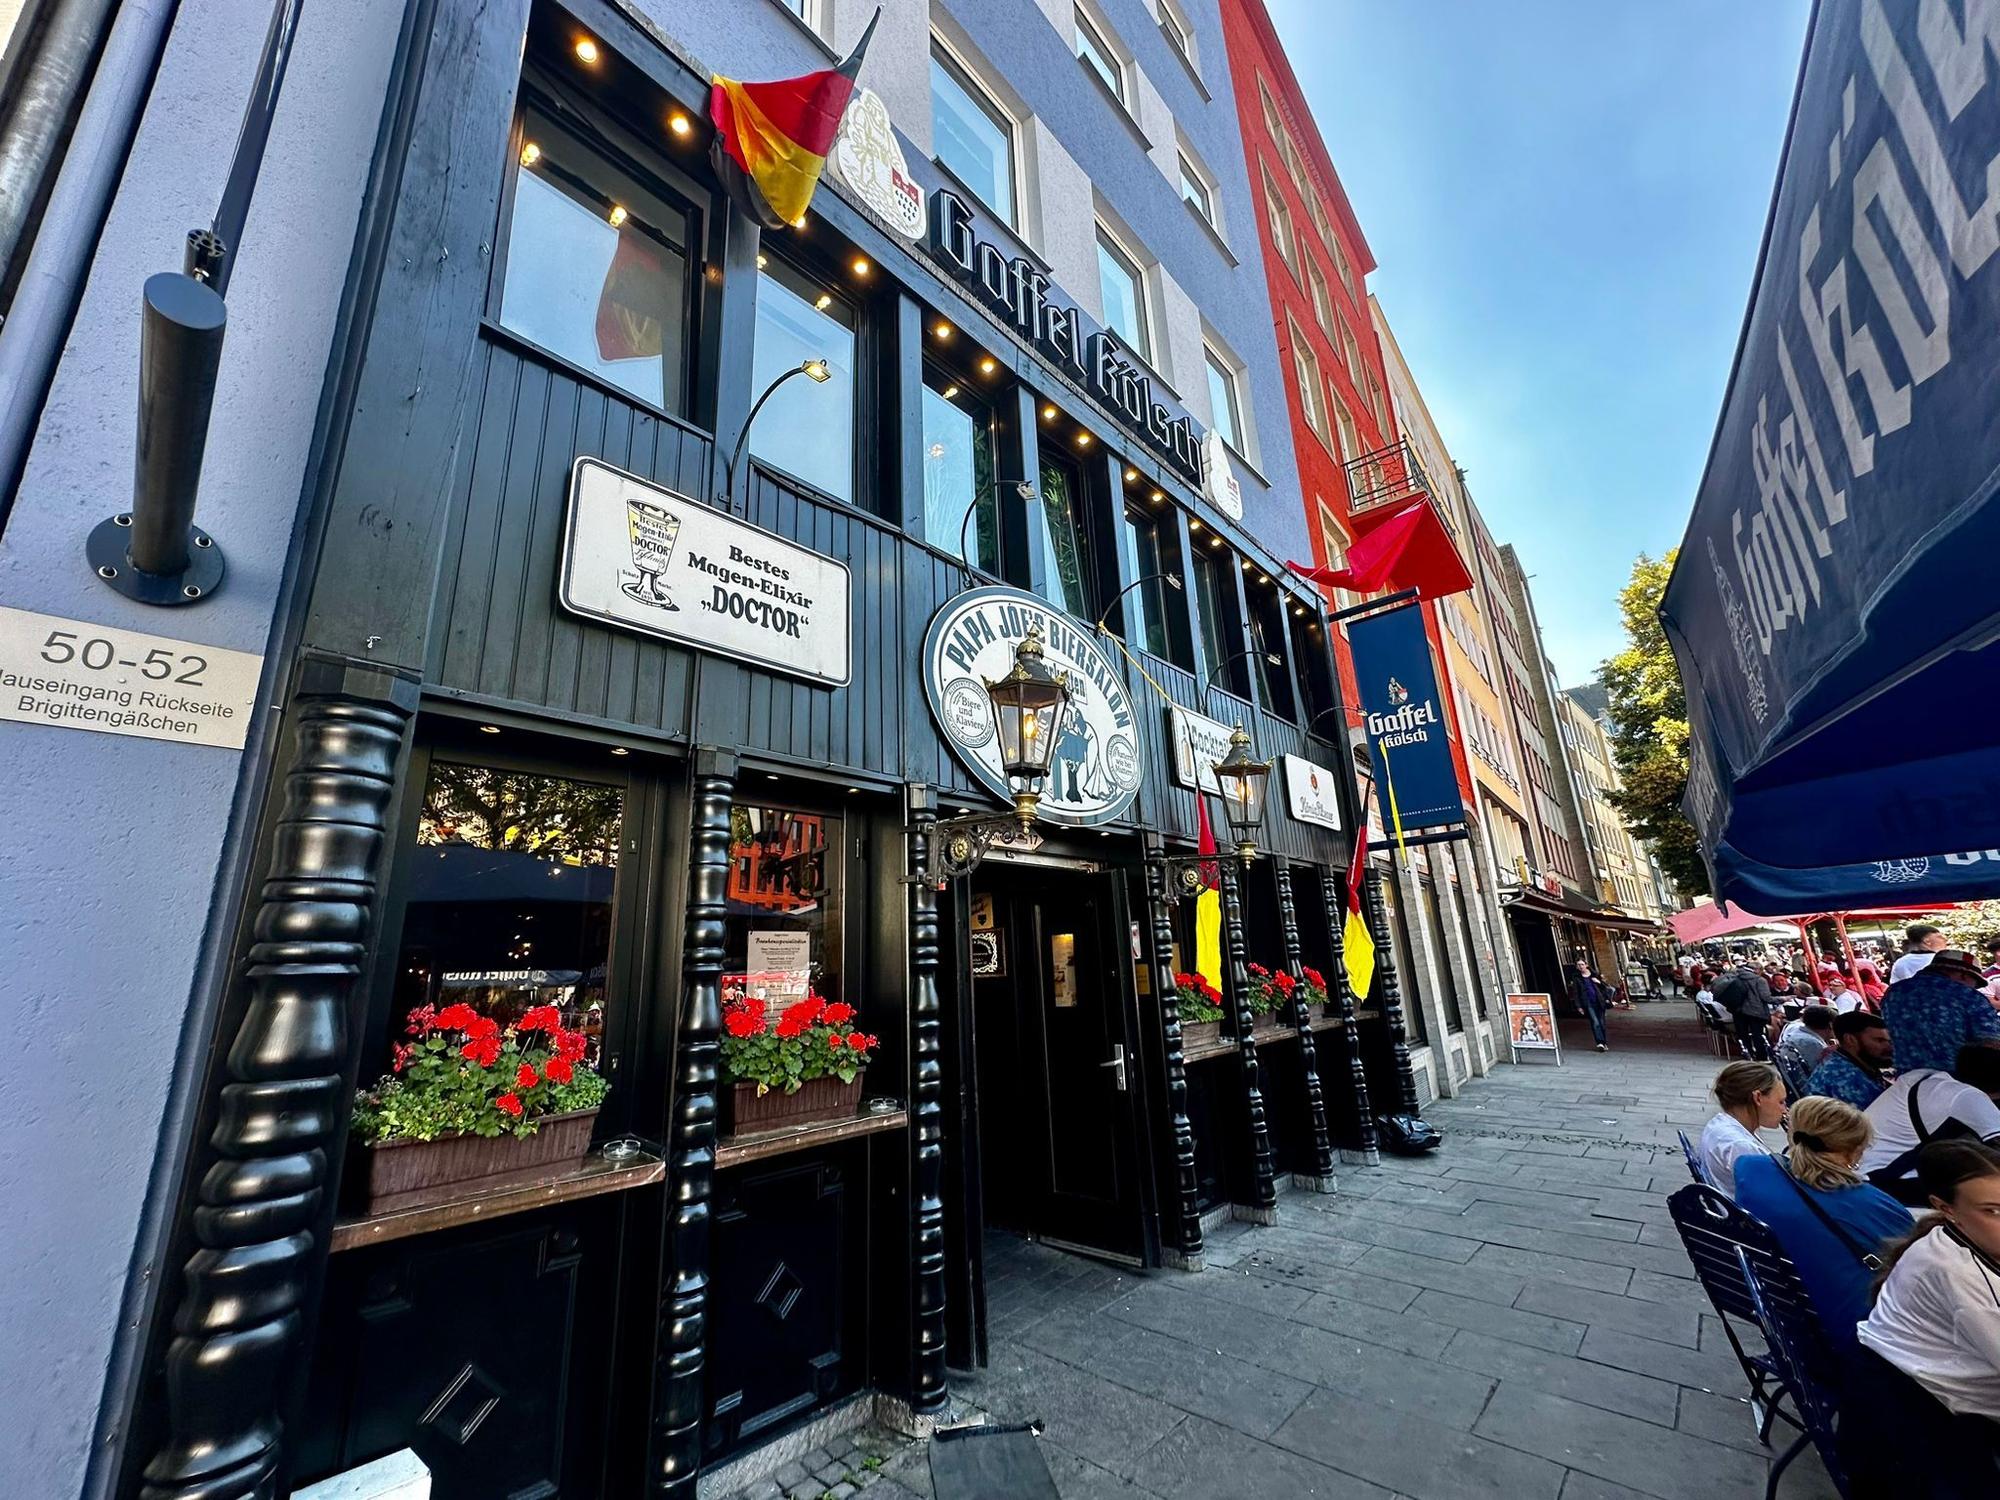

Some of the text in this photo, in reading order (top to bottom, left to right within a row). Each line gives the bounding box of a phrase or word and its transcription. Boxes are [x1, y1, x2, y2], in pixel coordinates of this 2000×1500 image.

[932, 188, 1205, 484] Gaffel Kölsch
[1732, 320, 1848, 656] Gaffel
[688, 552, 812, 609] Magen-Elixir
[729, 545, 790, 581] Bestes
[40, 631, 208, 686] 50-52
[946, 610, 996, 673] PAPA
[999, 605, 1046, 644] JOE'S
[1050, 619, 1130, 729] BIERSALON
[18, 695, 198, 734] Brigittengäßchen
[139, 690, 234, 718] Rückseite
[1368, 699, 1437, 736] Gaffel
[1384, 728, 1428, 749] Kölsch
